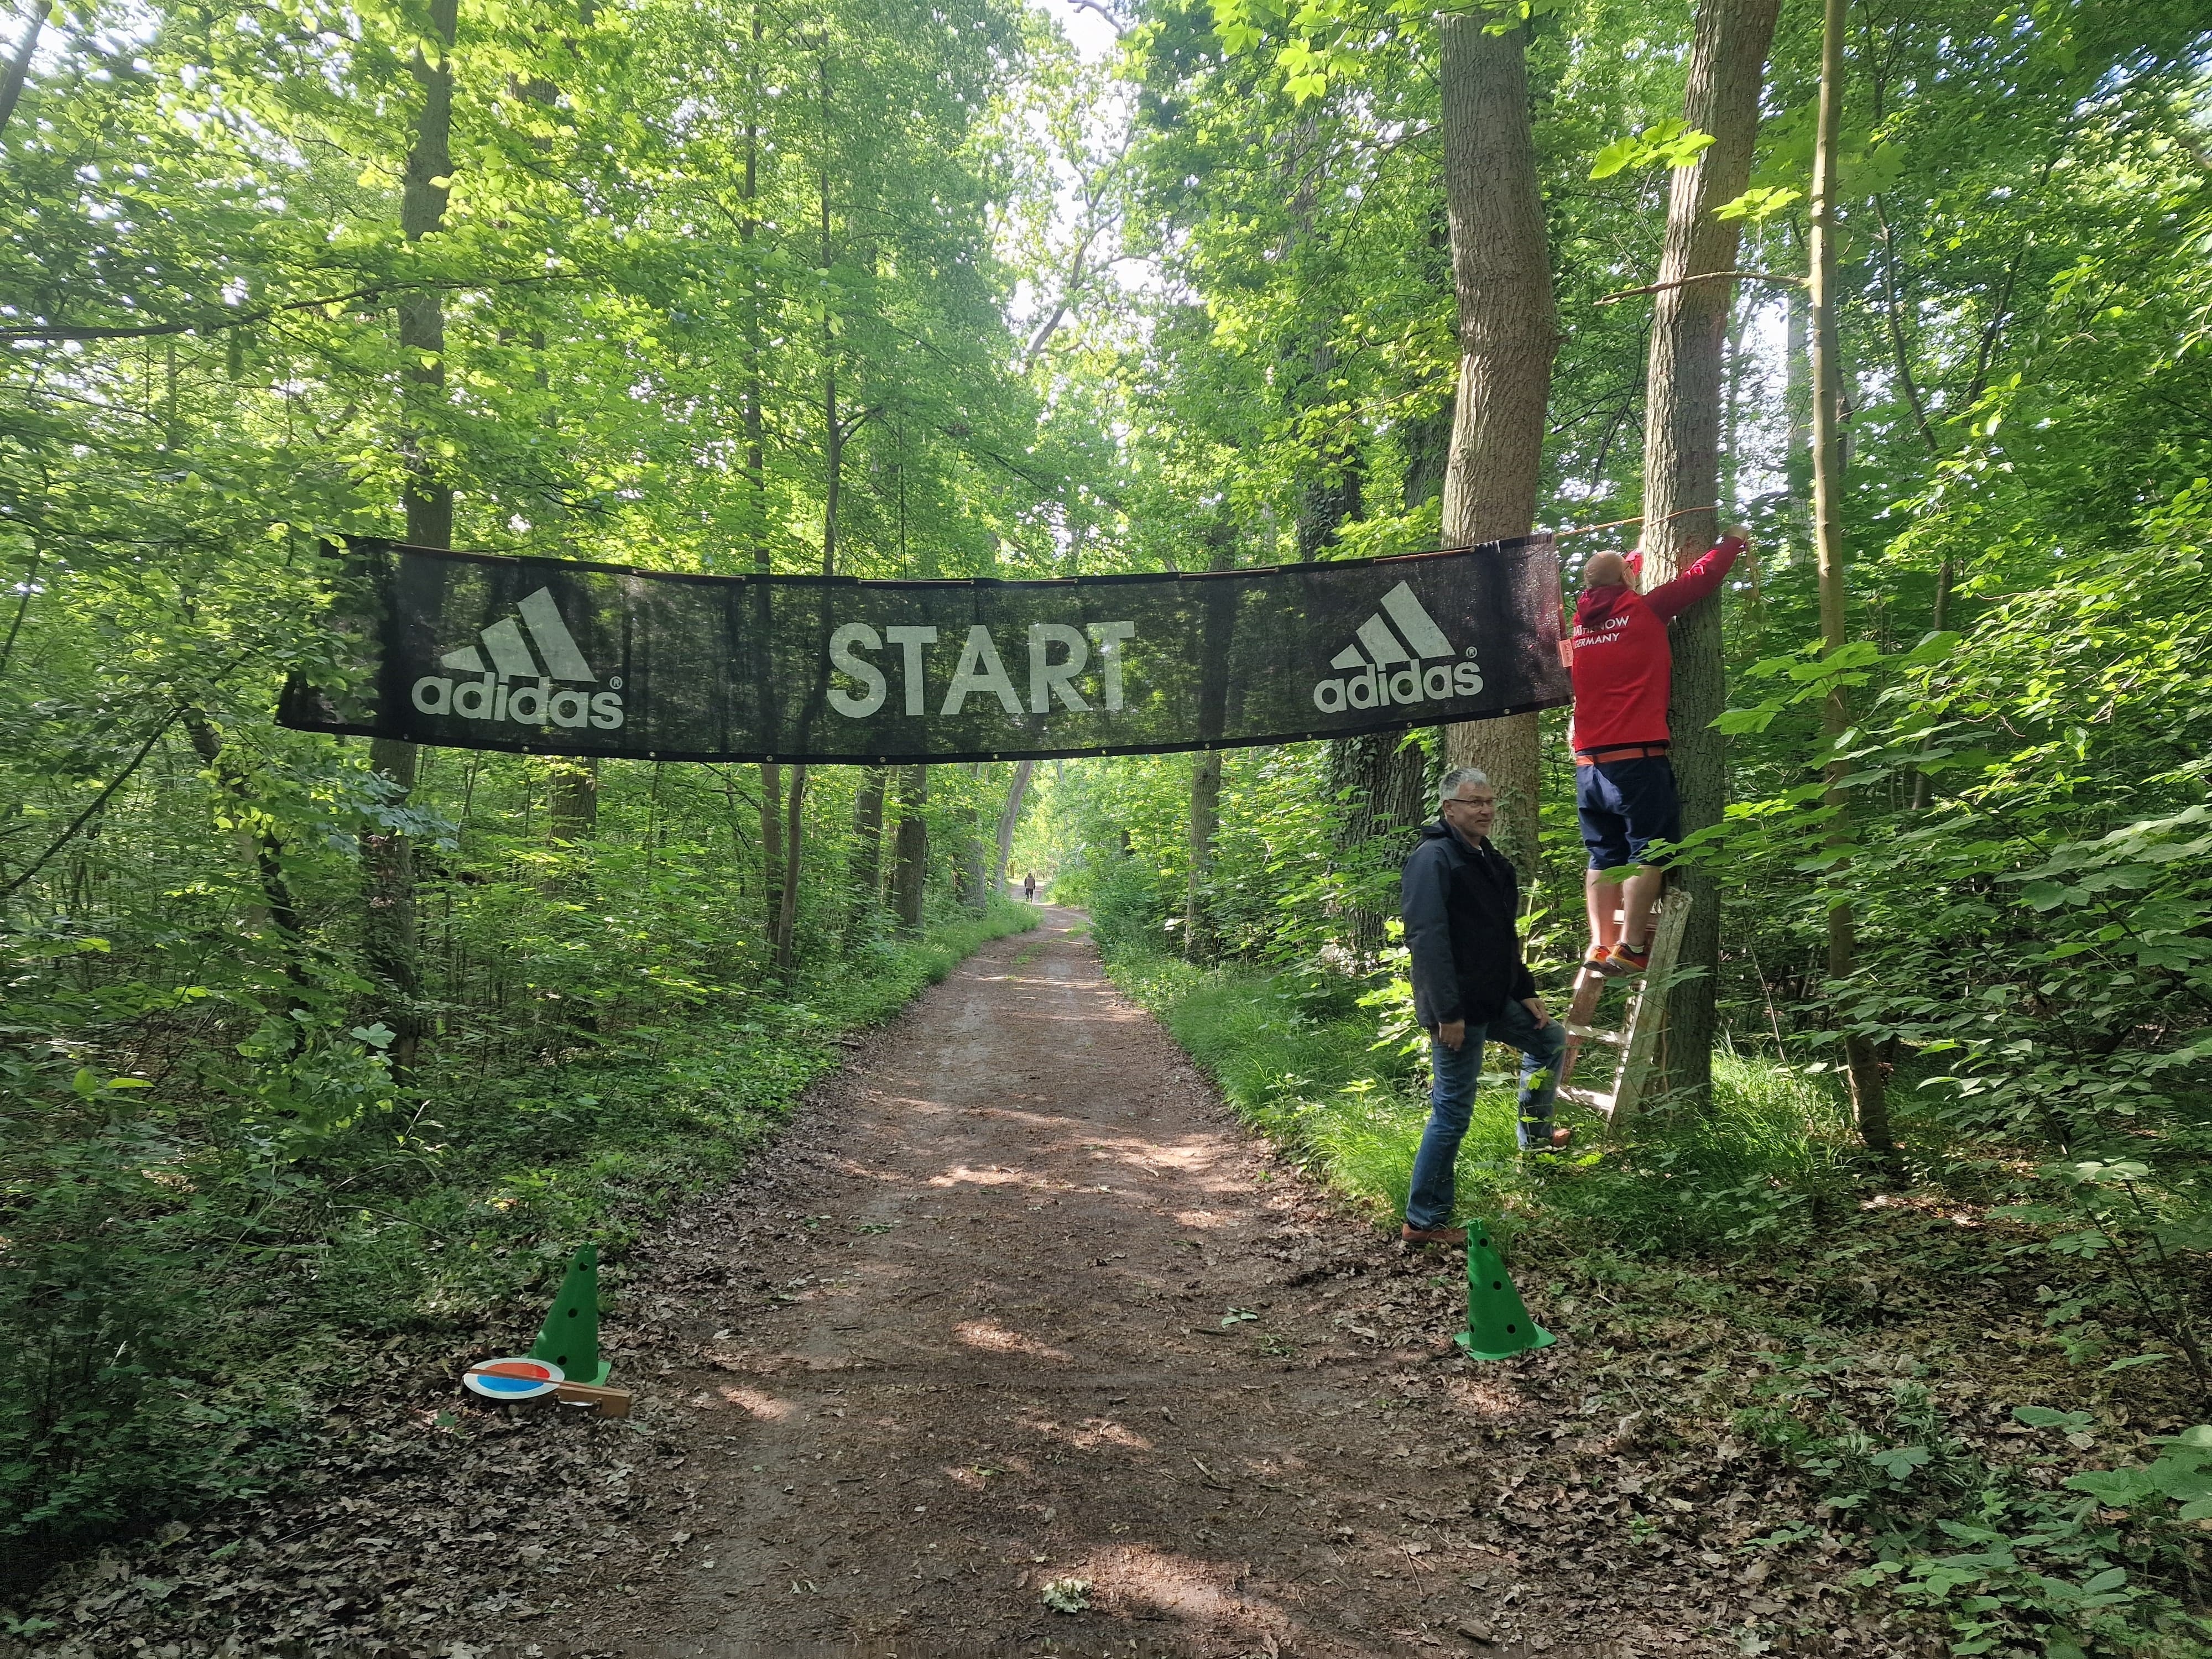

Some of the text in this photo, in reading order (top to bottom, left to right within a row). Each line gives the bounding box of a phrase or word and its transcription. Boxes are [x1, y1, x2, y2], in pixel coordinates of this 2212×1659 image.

[827, 620, 1135, 718] START
[1313, 659, 1484, 713] adidas
[411, 672, 624, 729] adidas
